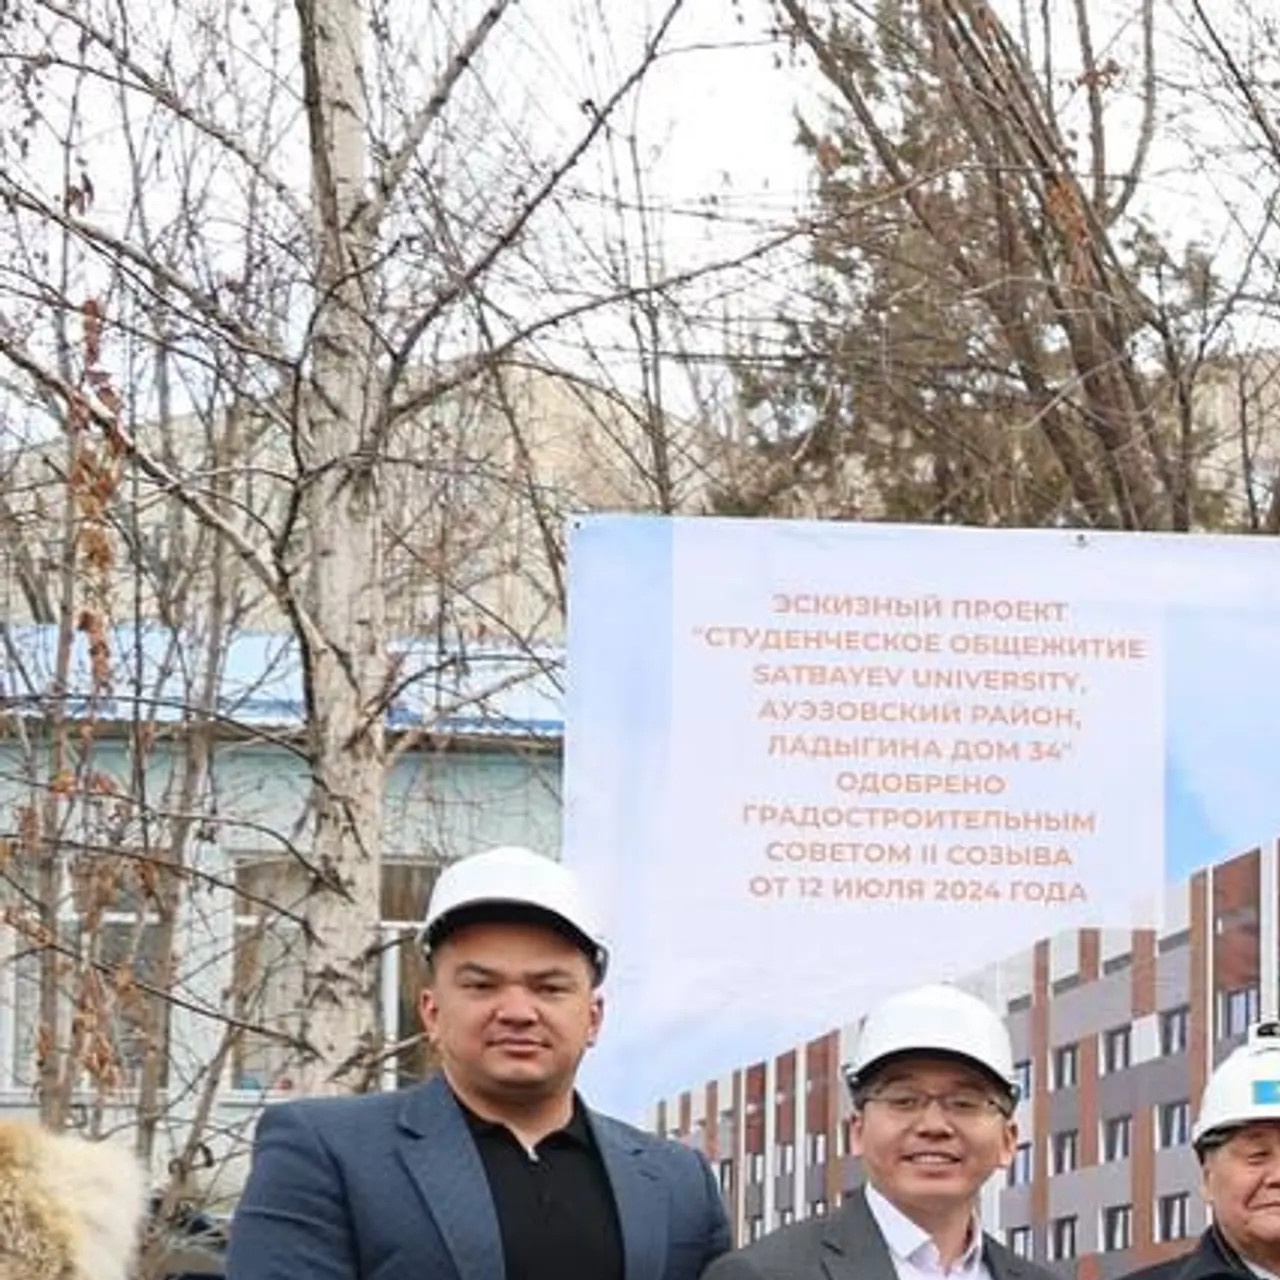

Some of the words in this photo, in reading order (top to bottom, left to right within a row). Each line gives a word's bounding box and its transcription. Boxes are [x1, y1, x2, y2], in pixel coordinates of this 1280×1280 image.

[772, 592, 943, 619] ЭСКИЗНЫЙ
[952, 599, 1068, 622] ПРОЕКТ
[693, 627, 941, 653] "СТУДЕНЧЕСКОЕ
[949, 634, 1145, 660] ОБЩЕЖИТИЕ
[753, 663, 904, 687] SATBAYEV
[912, 668, 1086, 694] UNIVERSITY,
[758, 699, 961, 724] АУЭЗОВСКИЙ
[971, 702, 1081, 730] РАЙОН,
[768, 734, 942, 759] ЛАДЫГИНА
[950, 739, 1020, 763] ДОМ
[836, 771, 1006, 796] ОДОБРЕНО
[743, 804, 1096, 833] ГРАДОСТРОИТЕЛЬНЫМ
[765, 840, 911, 864] СОВЕТОМ
[946, 845, 1073, 867] СОЗЫВА
[749, 876, 789, 898] ОТ
[797, 876, 823, 898] 12
[833, 878, 926, 900] ИЮЛЯ
[934, 879, 1002, 902] 2024
[1010, 881, 1088, 905] ГОДА
